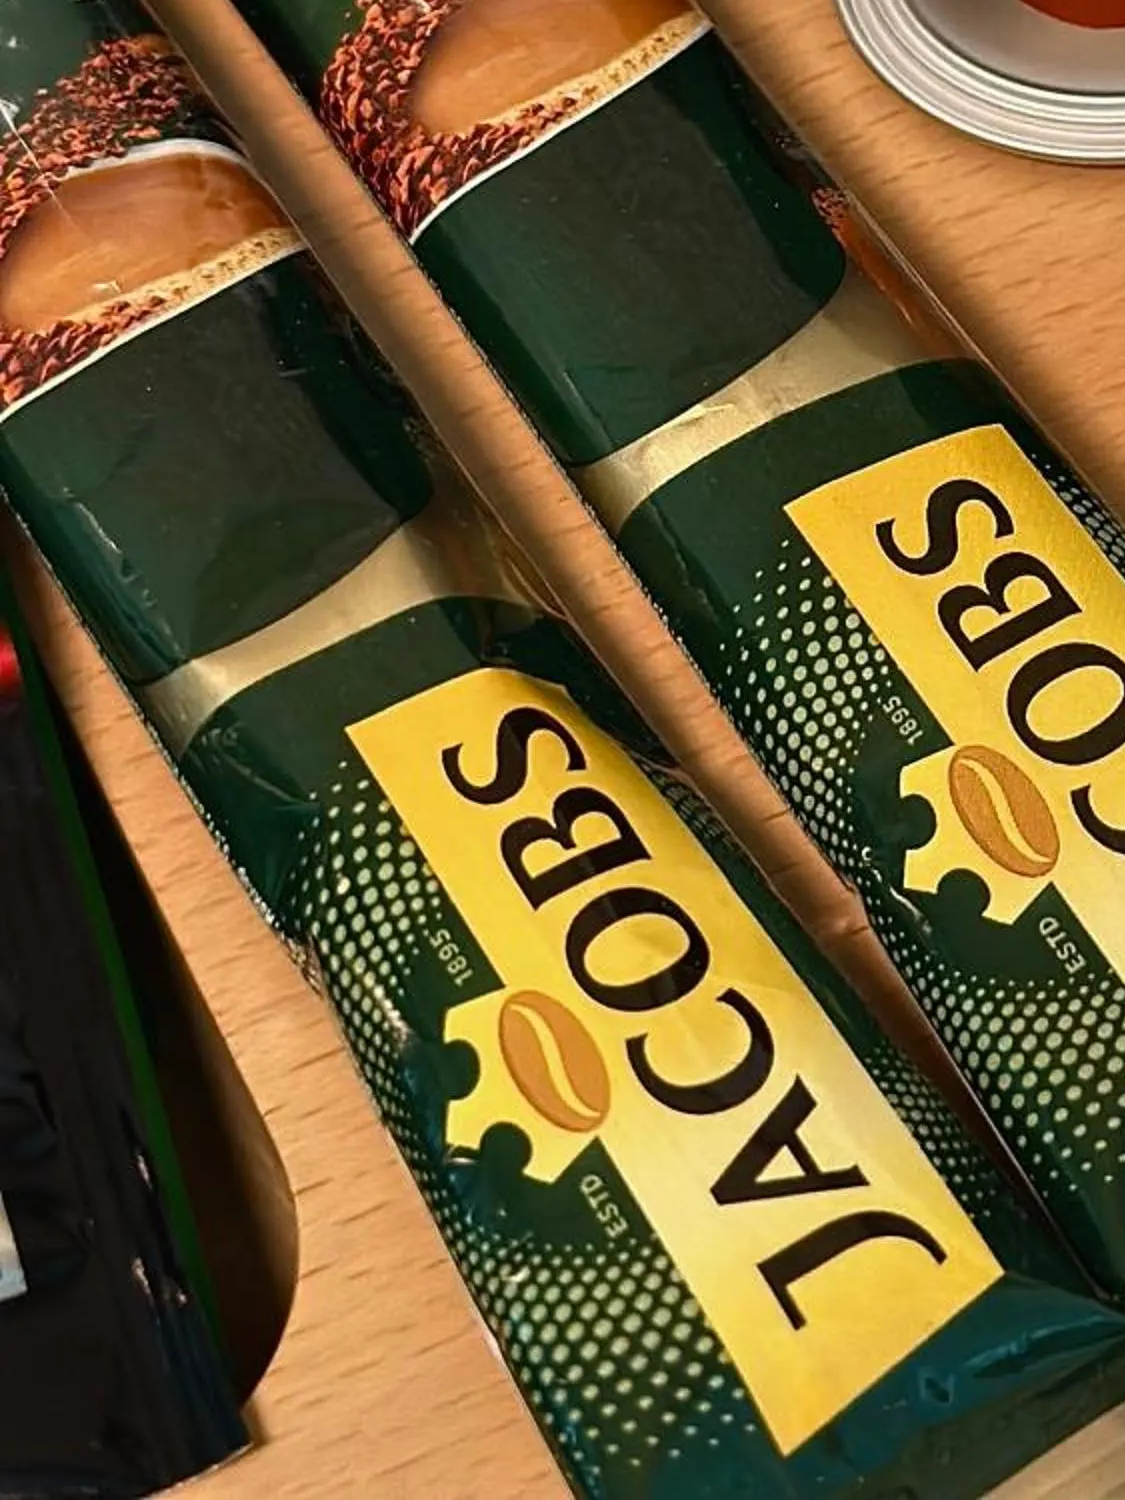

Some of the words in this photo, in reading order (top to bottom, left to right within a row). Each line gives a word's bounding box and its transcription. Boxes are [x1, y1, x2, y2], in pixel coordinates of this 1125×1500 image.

[882, 695, 924, 747] 1895
[429, 928, 474, 987] 1895
[1039, 916, 1086, 974] ESTD
[441, 705, 947, 1331] JACOBS
[580, 1174, 628, 1238] ESTD
